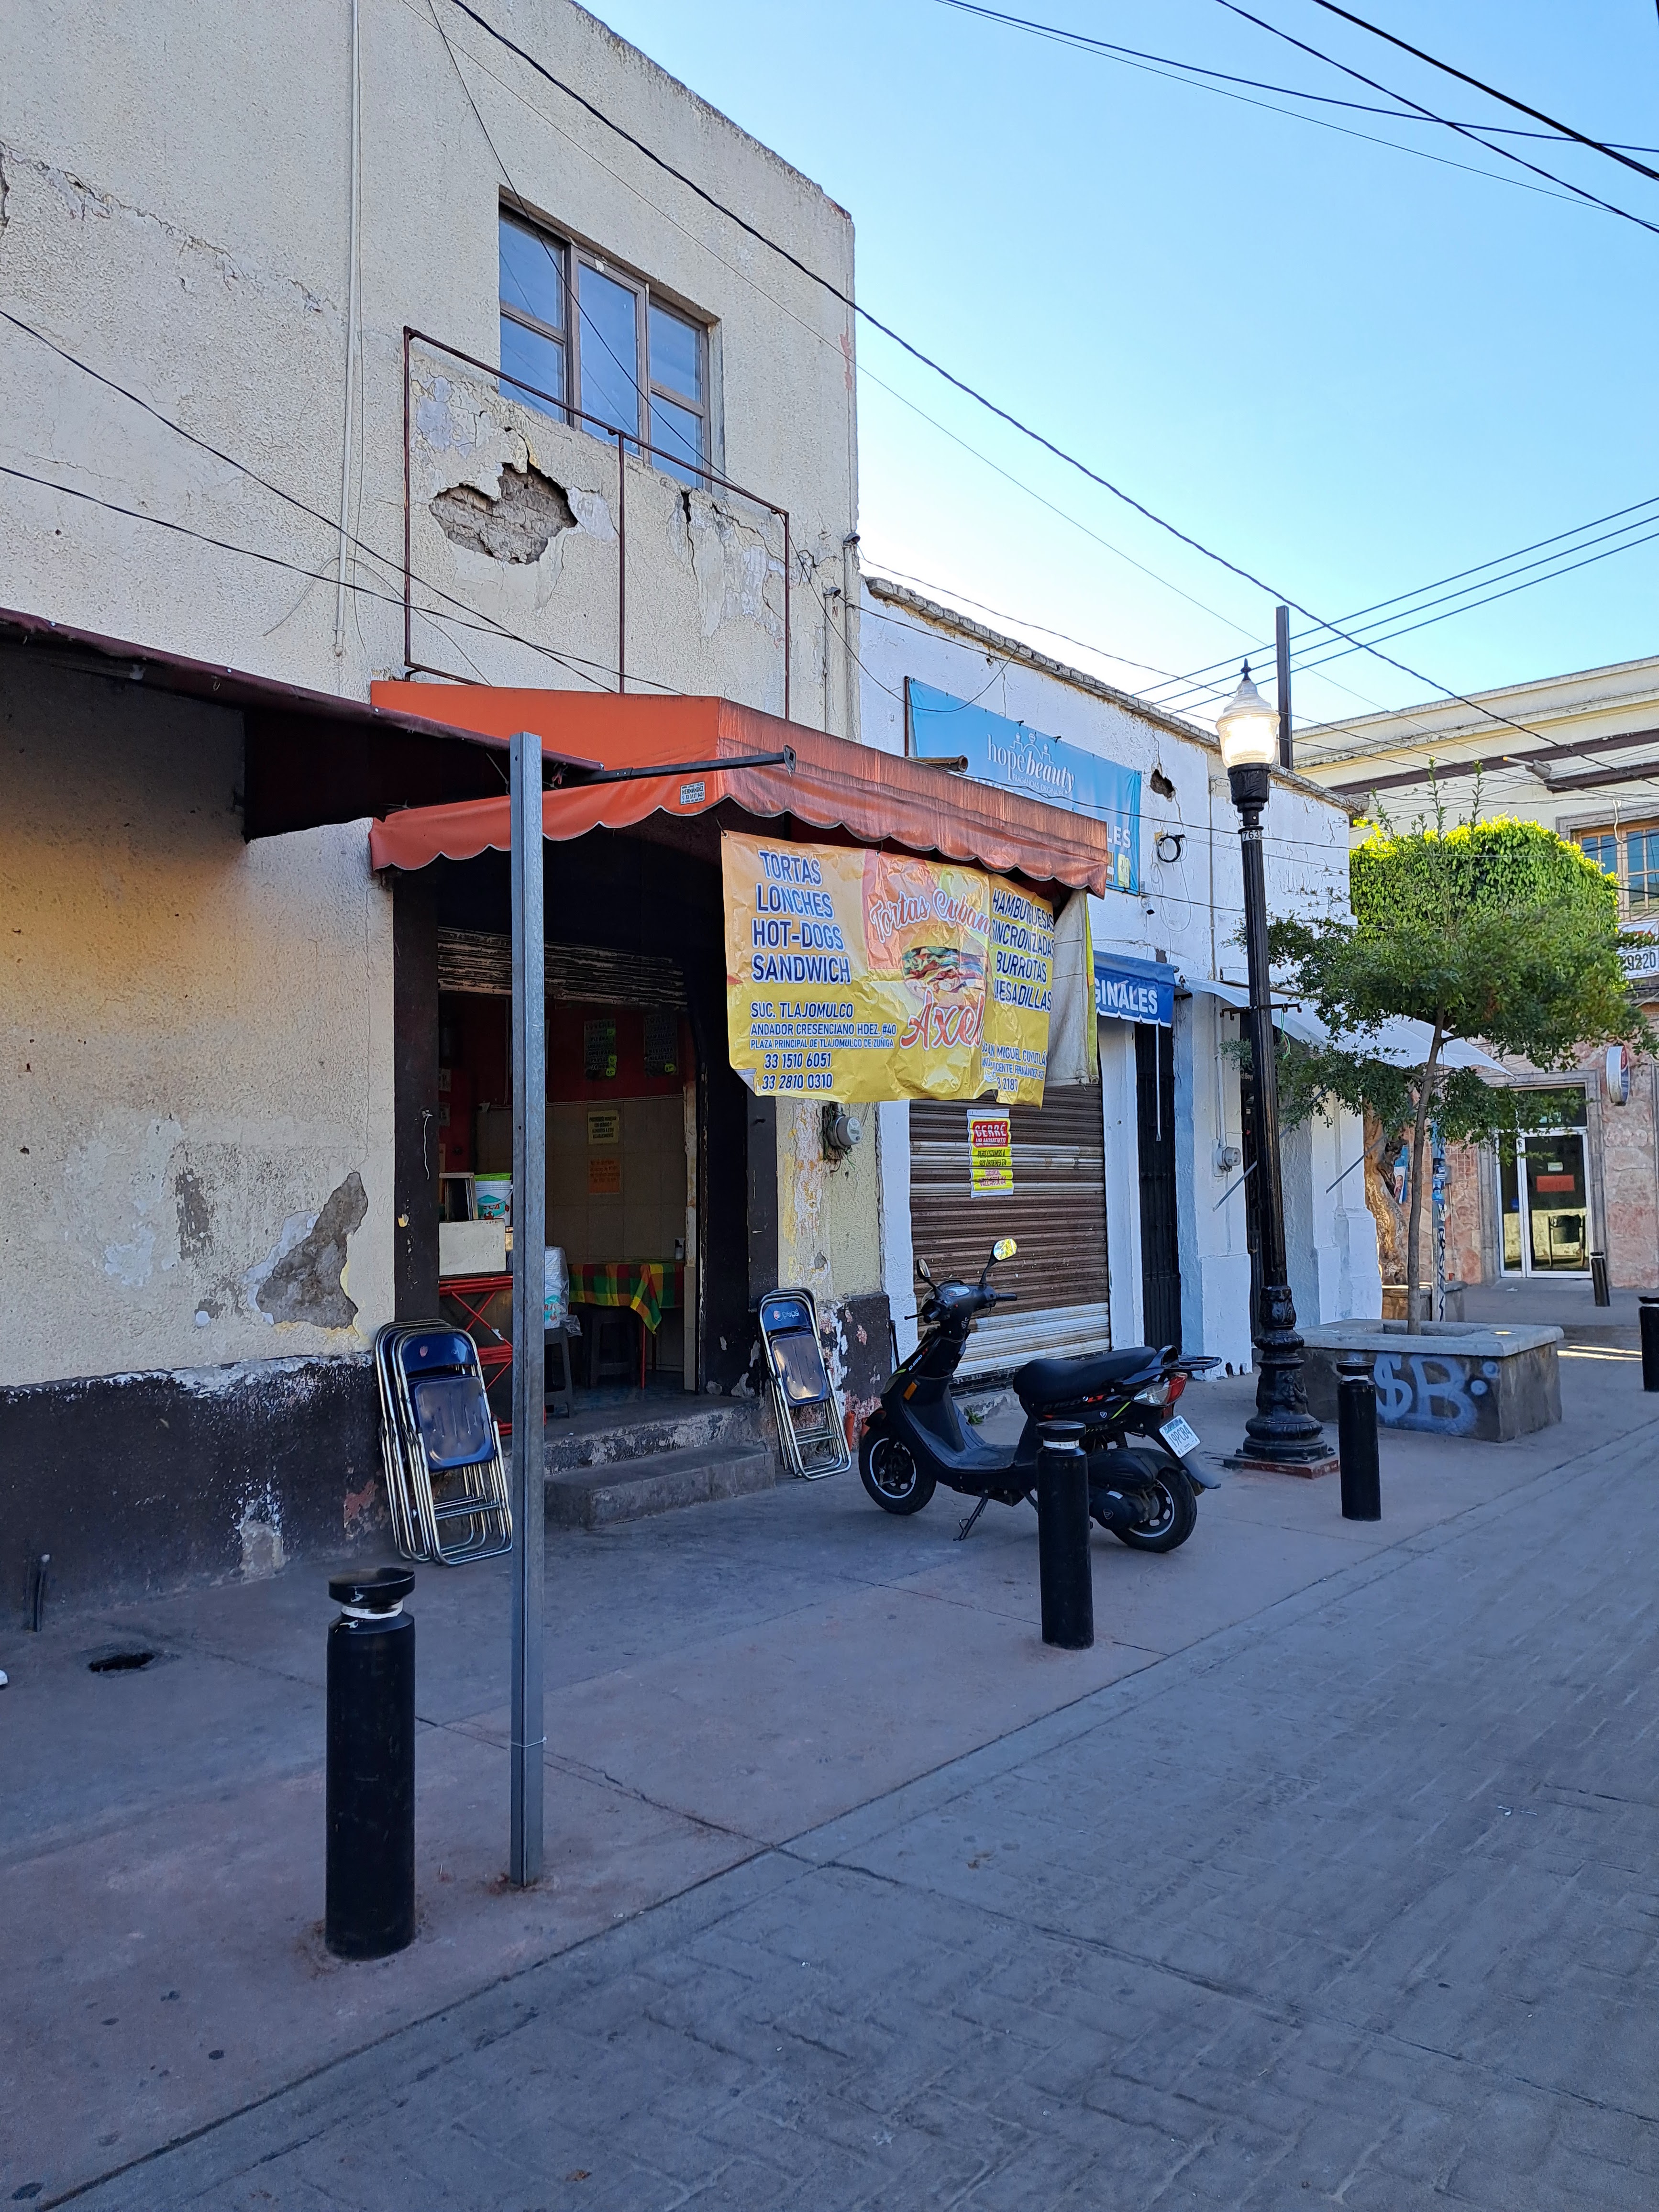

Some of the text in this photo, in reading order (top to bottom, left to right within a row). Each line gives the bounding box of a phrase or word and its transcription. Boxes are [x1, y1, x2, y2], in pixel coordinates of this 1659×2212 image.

[759, 852, 821, 885] TORTAS
[757, 885, 833, 918] LONCHES
[870, 890, 991, 942] Tortas Cuban
[753, 920, 844, 950] HOT-DOGS
[752, 954, 851, 983] SANDWICH
[996, 951, 1047, 983] BURROTAS
[995, 977, 1051, 1011] UESADILLAS
[751, 1002, 853, 1018] SUC. TLAJOMULCO
[901, 990, 985, 1049] Axel
[751, 1023, 896, 1036] ANDADOR CRESENCIANO HDEZ. #40
[751, 1037, 894, 1049] PLAZA PRINCIPAL DE TLAJOMULCO DE ZUÑIGA
[764, 1052, 831, 1069] 33 1510 6051
[997, 1045, 1021, 1061] MIGUEL
[762, 1073, 833, 1090] 33 2810 0310
[1003, 1077, 1018, 1091] 2187
